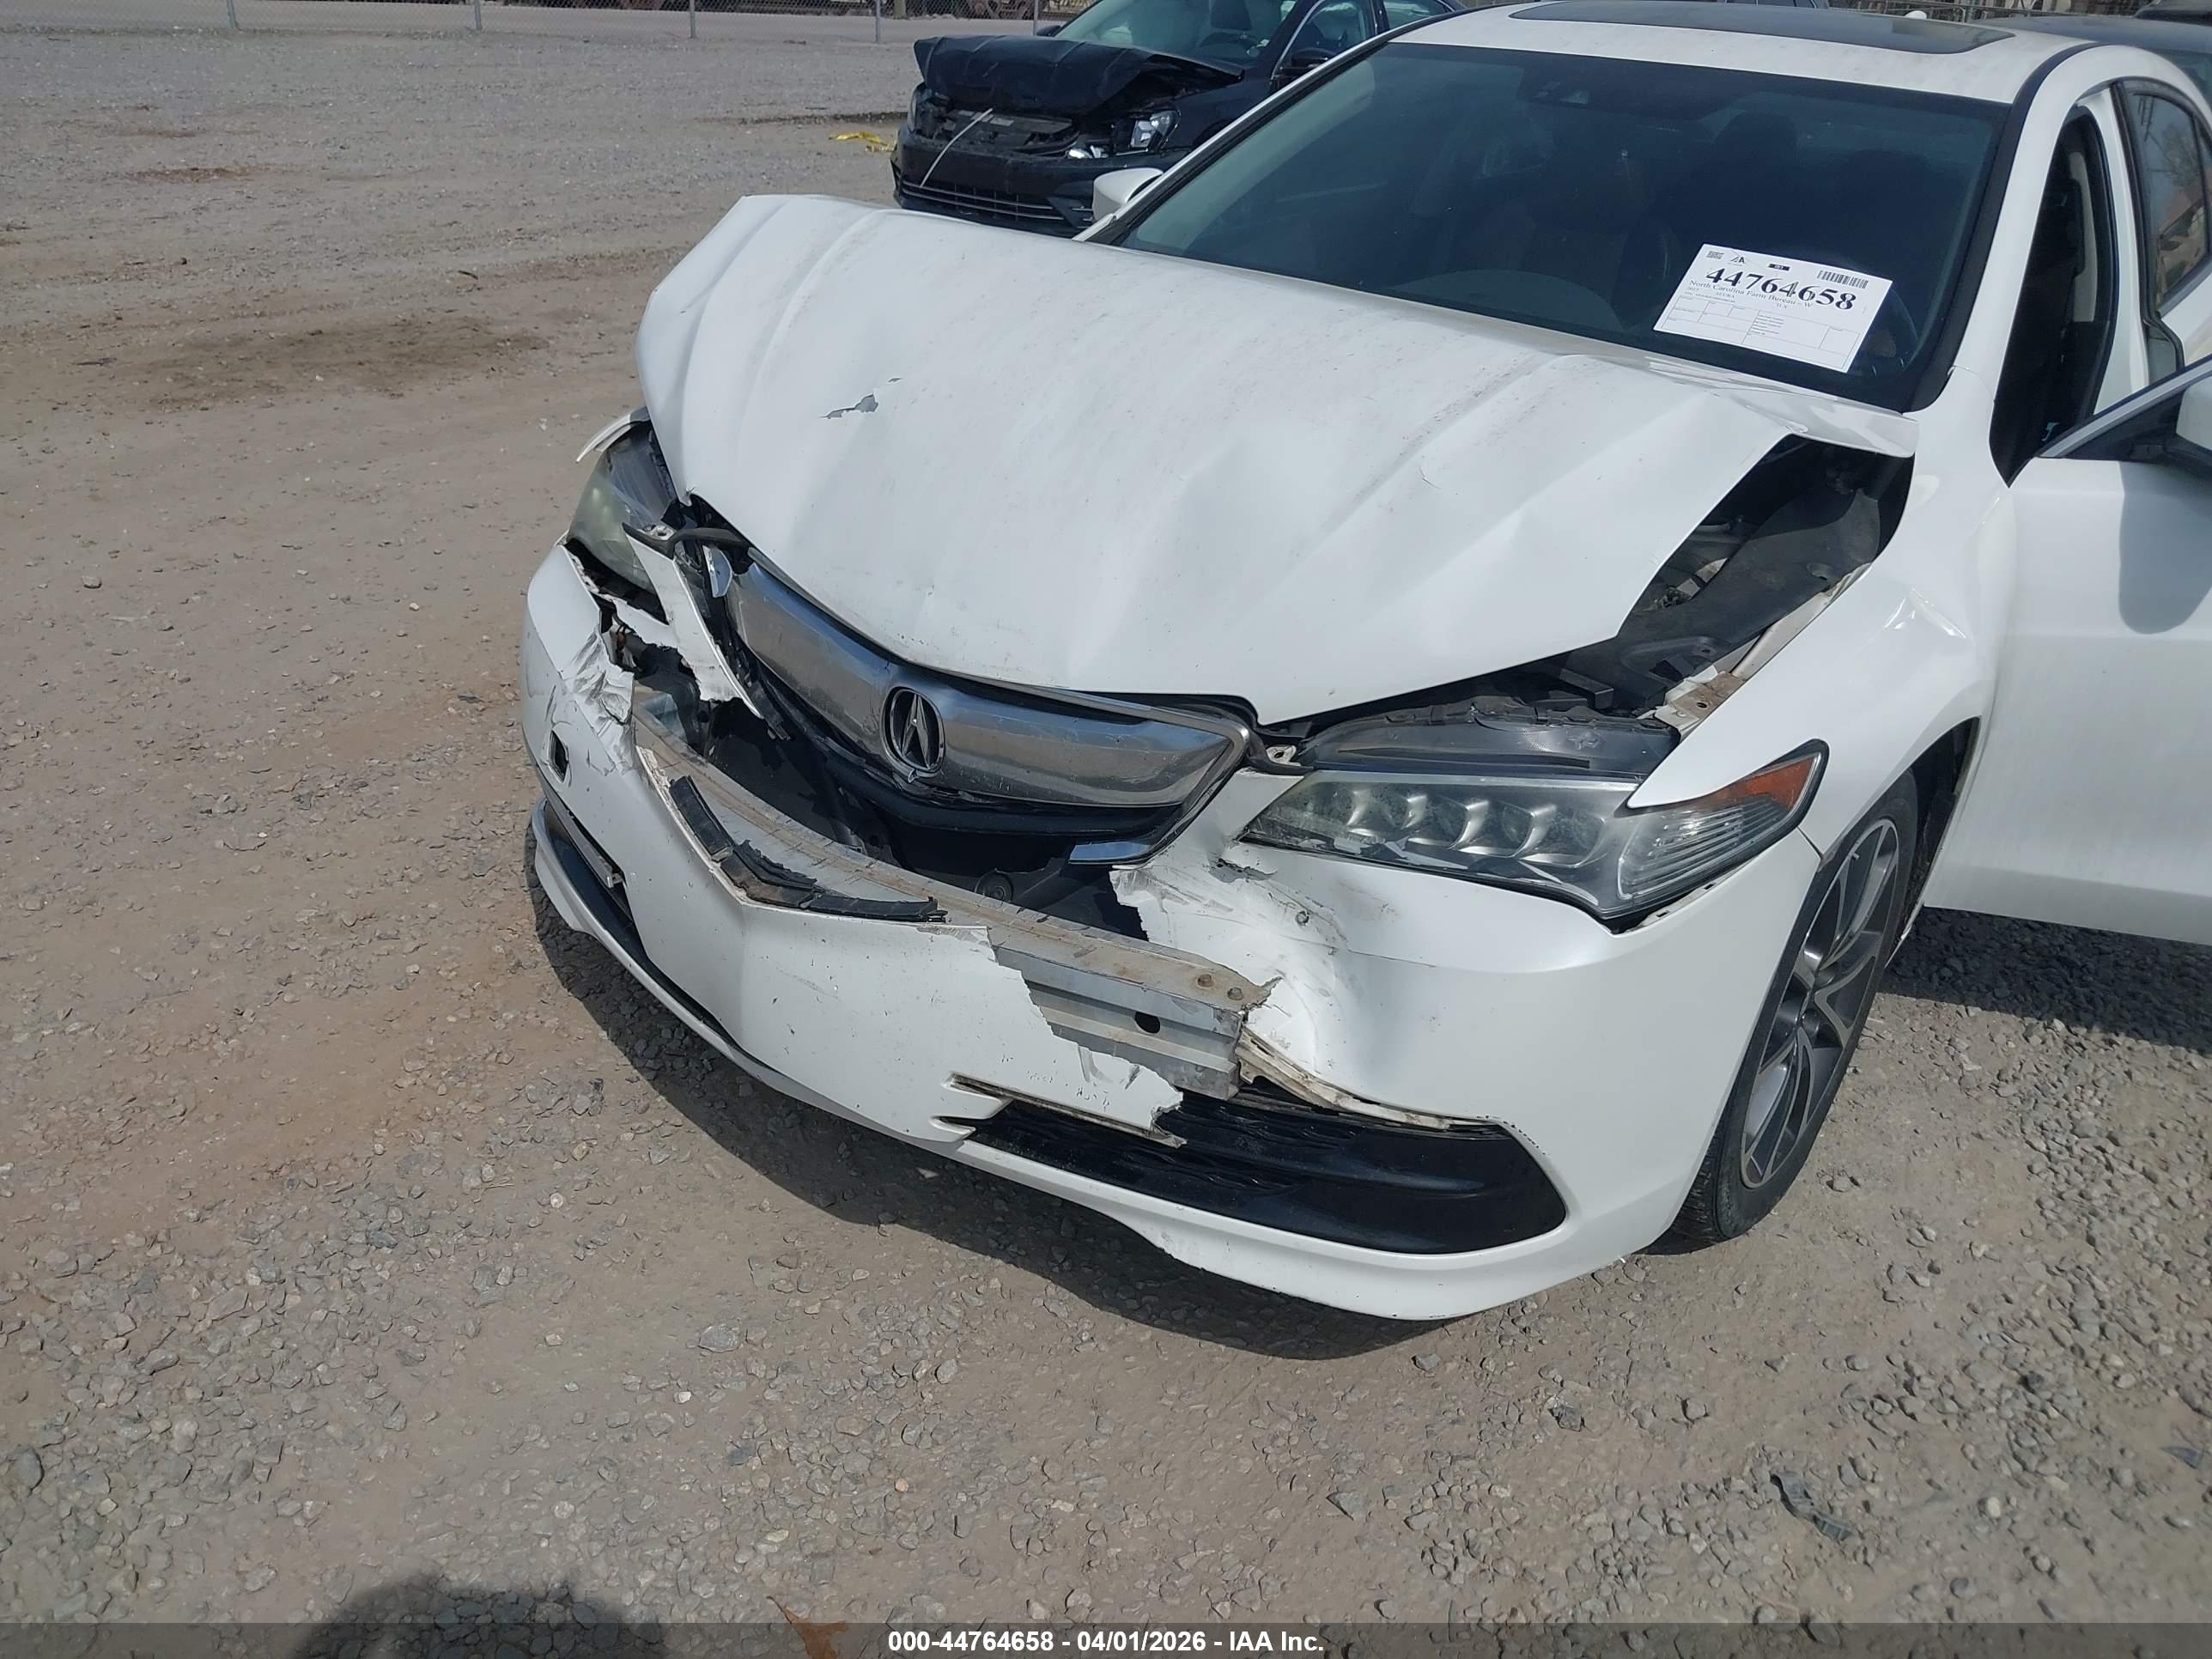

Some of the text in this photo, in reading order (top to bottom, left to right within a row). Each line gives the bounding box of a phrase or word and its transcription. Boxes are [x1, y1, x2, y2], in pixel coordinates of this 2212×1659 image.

[1689, 280, 1711, 289] North
[1712, 284, 1745, 295] Carolina
[1747, 290, 1766, 300] Farm
[1769, 294, 1796, 305] Bureau
[1705, 267, 1857, 310] 44764658
